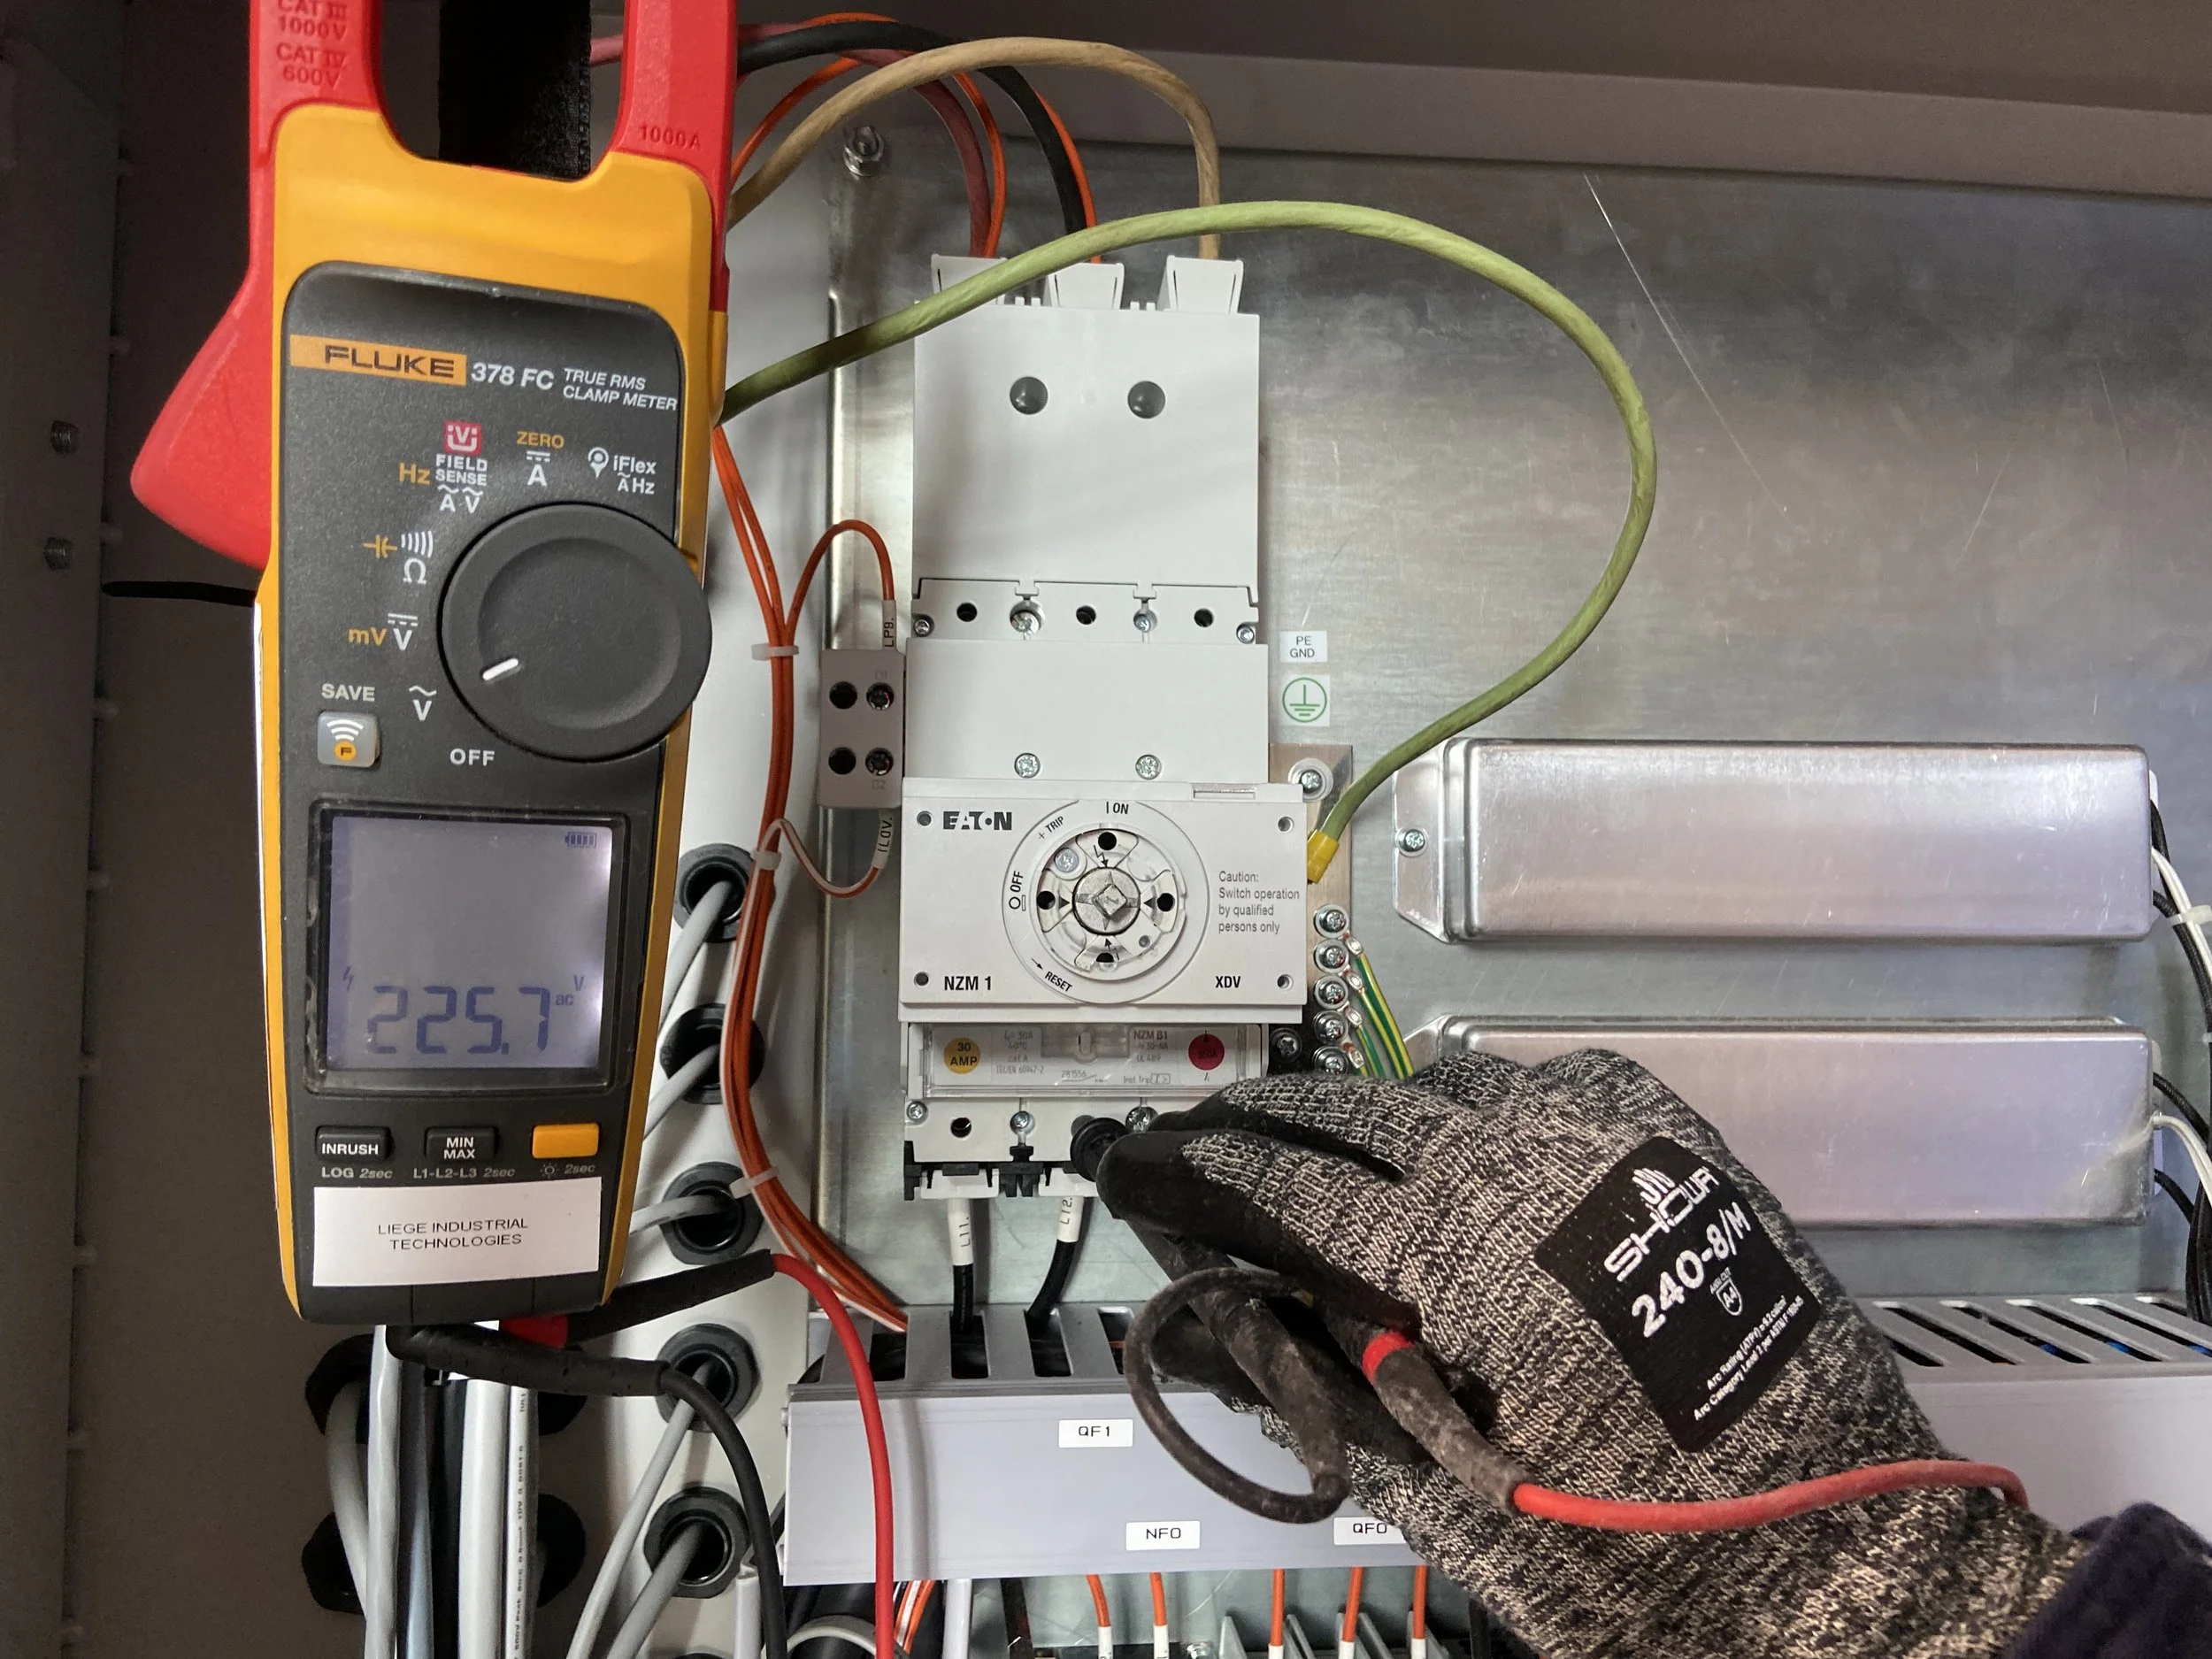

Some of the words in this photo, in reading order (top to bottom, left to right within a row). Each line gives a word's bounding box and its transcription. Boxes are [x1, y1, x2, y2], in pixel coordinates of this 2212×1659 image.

[279, 15, 347, 42] 1000V
[276, 42, 319, 64] CAT
[283, 64, 342, 90] 600V
[638, 126, 702, 150] 1000A
[325, 344, 455, 378] FLUKE
[471, 361, 515, 385] 378
[520, 368, 555, 390] FC
[564, 368, 605, 387] TRUE
[609, 373, 646, 391] RMS
[563, 386, 619, 404] CLAMP
[621, 392, 678, 411] METER
[516, 431, 565, 449] ZERO
[435, 453, 488, 472] FIELD
[612, 456, 657, 475] iFlex
[399, 463, 431, 486] Hz
[434, 468, 488, 487] SENSE
[632, 478, 656, 495] Hz
[348, 627, 387, 646] mV
[1295, 635, 1312, 646] PE
[1289, 648, 1316, 658] GND
[321, 683, 375, 703] SAVE
[449, 749, 495, 766] OFF
[1112, 803, 1130, 815] ON
[1045, 815, 1065, 833] TRIP
[1010, 870, 1025, 894] OFF
[1218, 870, 1259, 883] Caution:
[1218, 887, 1251, 899] Switch
[1254, 887, 1300, 902] operation
[1218, 903, 1231, 918] by
[1233, 903, 1274, 918] qualified
[1218, 922, 1257, 934] persons
[1260, 920, 1280, 935] only
[943, 975, 979, 991] NZM
[984, 975, 992, 991] 1
[1044, 971, 1073, 992] RESET
[1215, 975, 1241, 989] XDV
[366, 985, 550, 1055] 225.7
[574, 975, 585, 992] V
[1133, 1029, 1154, 1040] NZM
[956, 1042, 972, 1052] 30
[949, 1056, 978, 1066] AMP
[321, 1142, 380, 1156] INRUSH
[446, 1136, 475, 1148] MIN
[443, 1148, 476, 1160] MAX
[321, 1166, 354, 1179] LOG
[359, 1167, 394, 1179] 2sec
[413, 1167, 478, 1179] L1-L2-L3
[482, 1166, 516, 1179] 2sec
[378, 1222, 427, 1236] LIEGE
[432, 1217, 529, 1233] INDUSTRIAL
[1604, 1166, 1719, 1281] SHOWA
[390, 1233, 523, 1250] TECHNOLOGIES
[1632, 1202, 1751, 1337] 240-8/M
[1079, 1425, 1111, 1437] QF1
